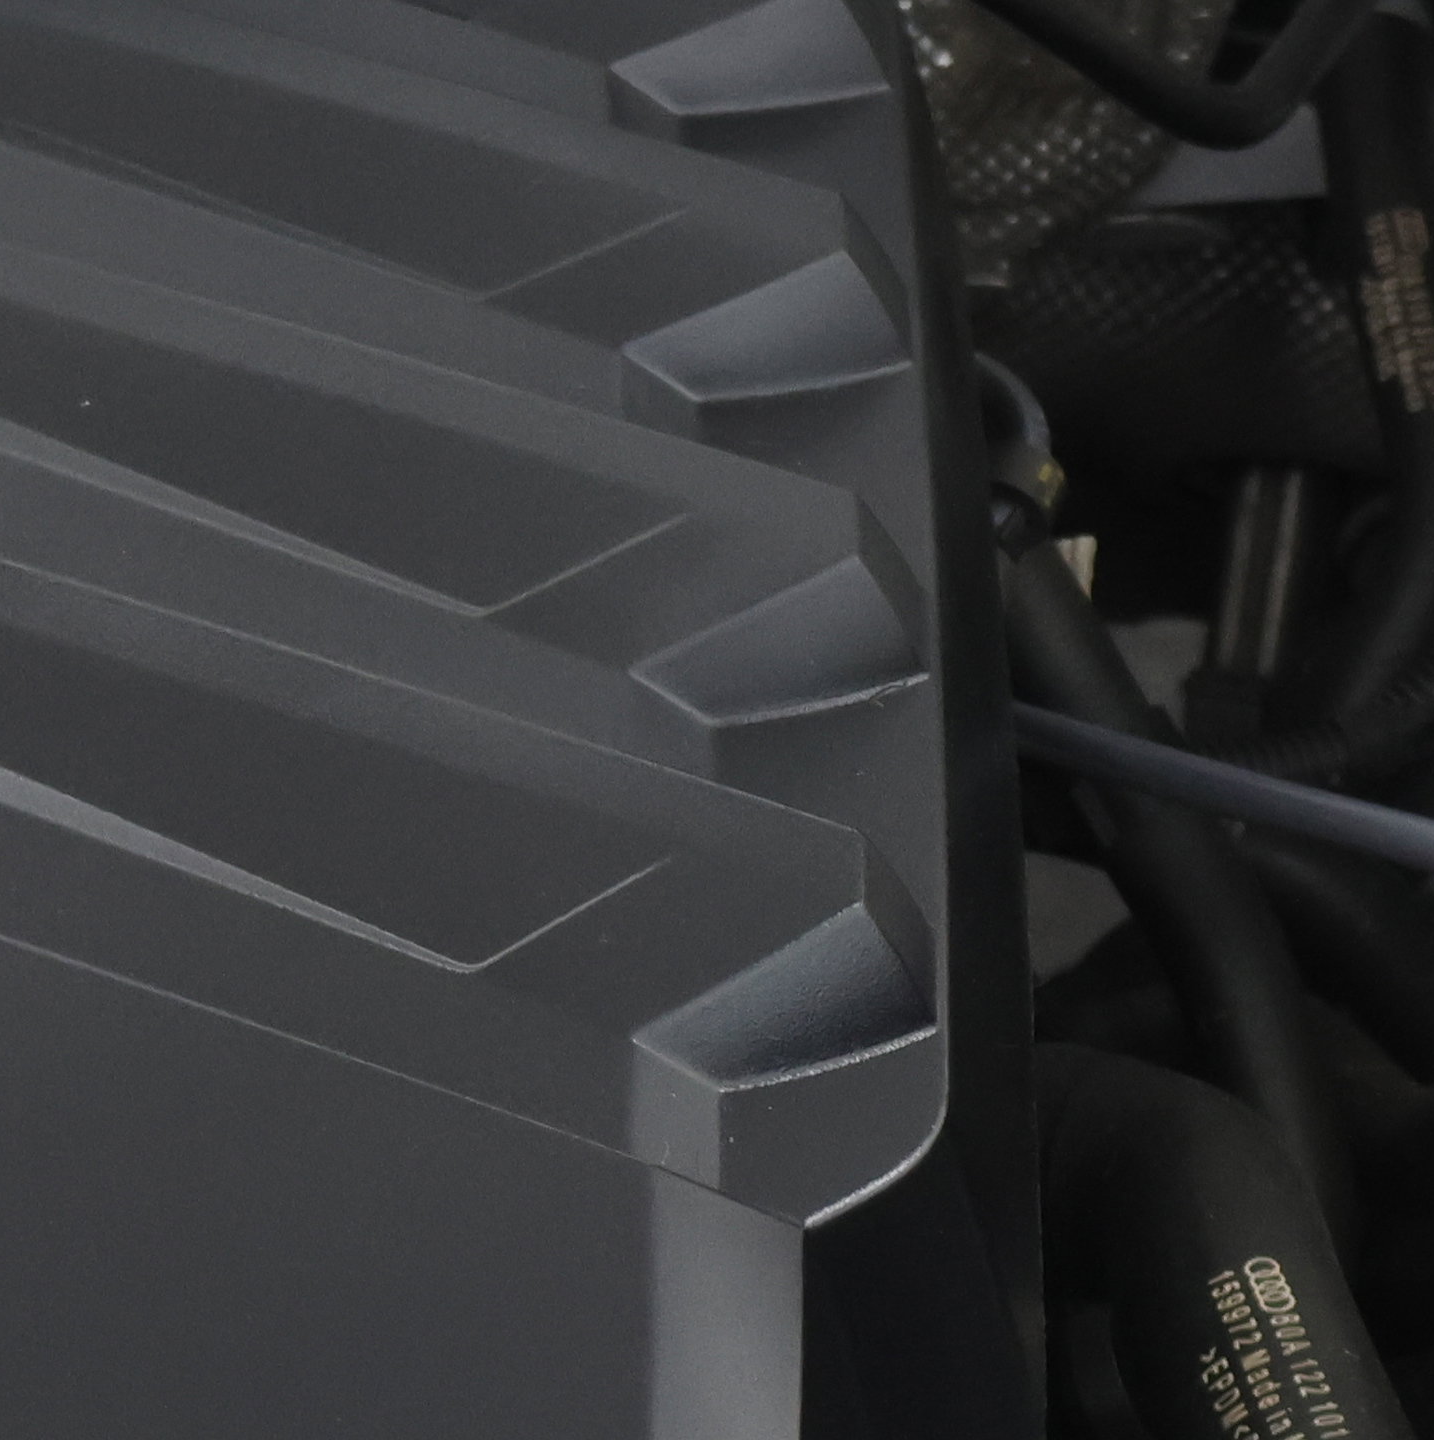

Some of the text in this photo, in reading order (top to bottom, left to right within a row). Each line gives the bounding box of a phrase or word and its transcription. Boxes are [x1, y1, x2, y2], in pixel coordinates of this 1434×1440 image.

[1207, 1270, 1263, 1351] 159972
[1240, 1348, 1283, 1410] Made
[1266, 1407, 1293, 1436] in
[1270, 1313, 1312, 1357] 80A
[1290, 1358, 1332, 1399] 122
[1309, 1401, 1352, 1440] 101
